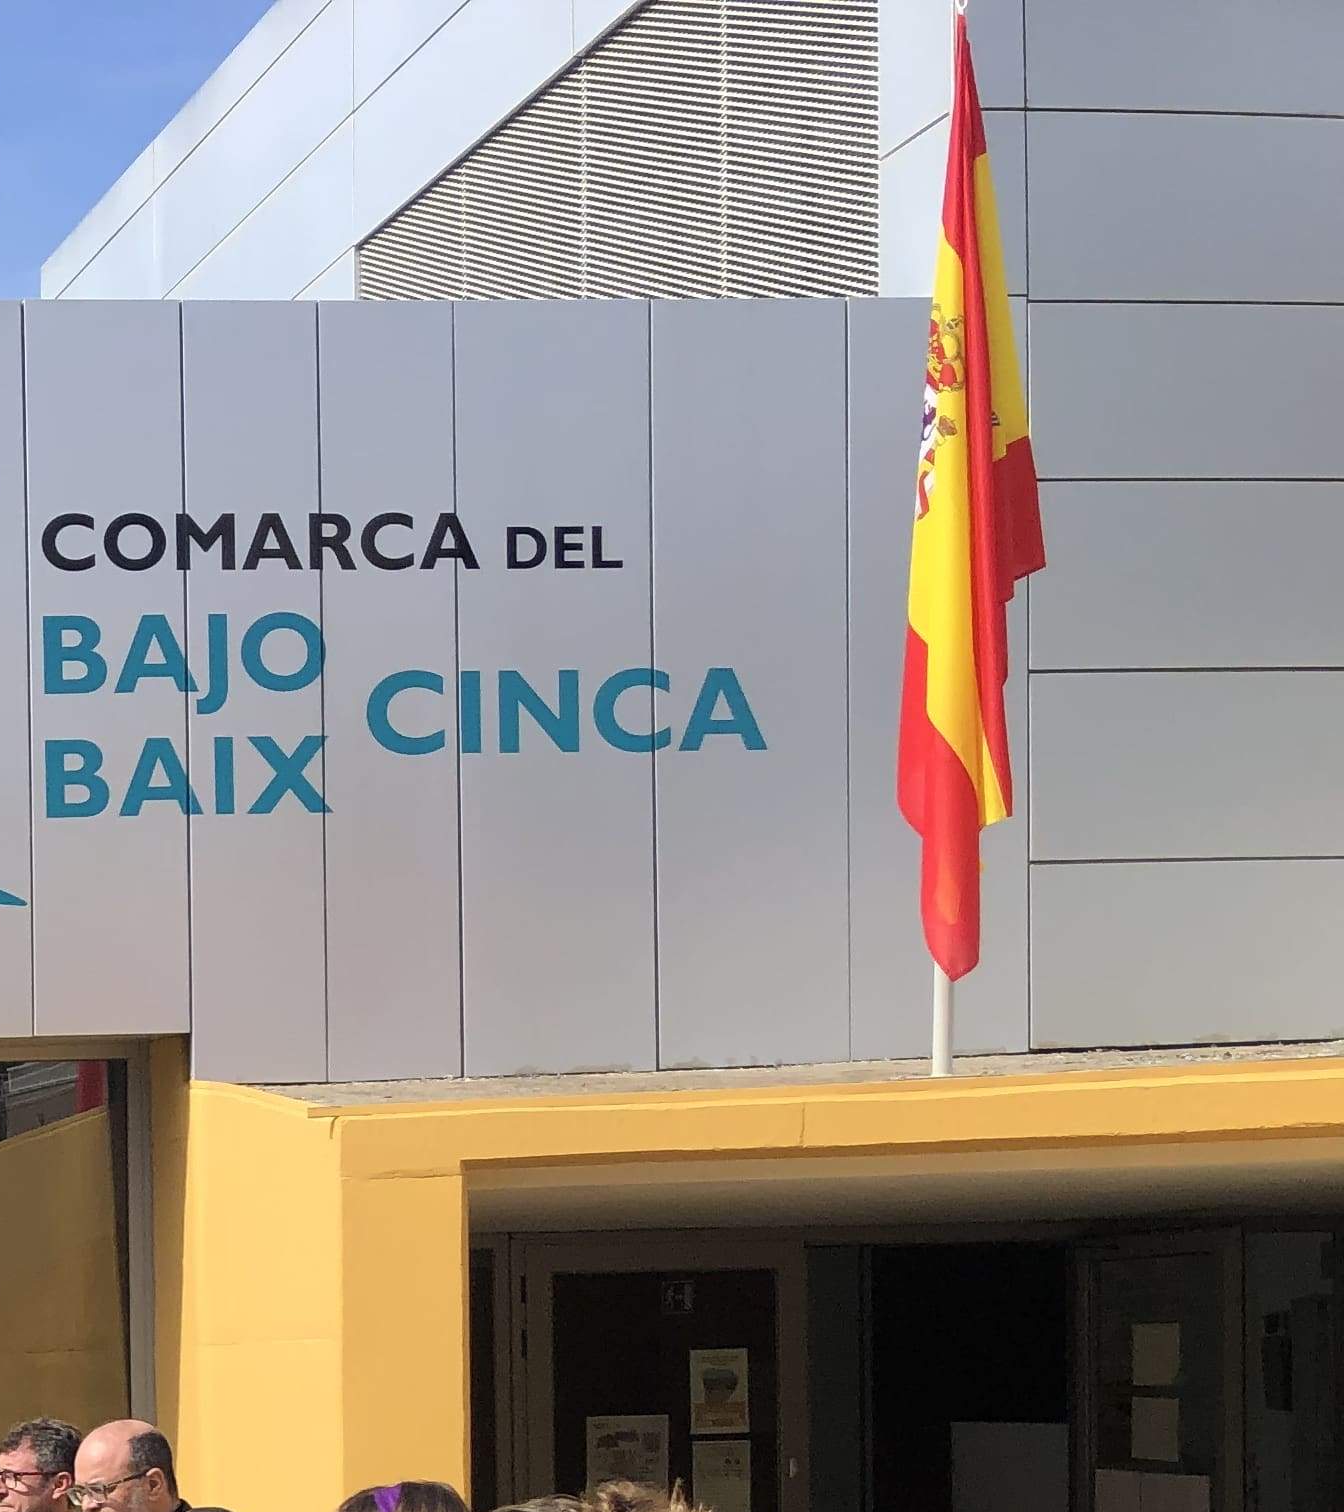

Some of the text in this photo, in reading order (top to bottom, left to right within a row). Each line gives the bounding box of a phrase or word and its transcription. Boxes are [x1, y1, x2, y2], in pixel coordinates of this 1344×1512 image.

[41, 512, 623, 571] COMARCA DEL
[43, 613, 327, 714] BAJO
[367, 667, 766, 755] CINCA
[45, 735, 333, 817] BAIX
